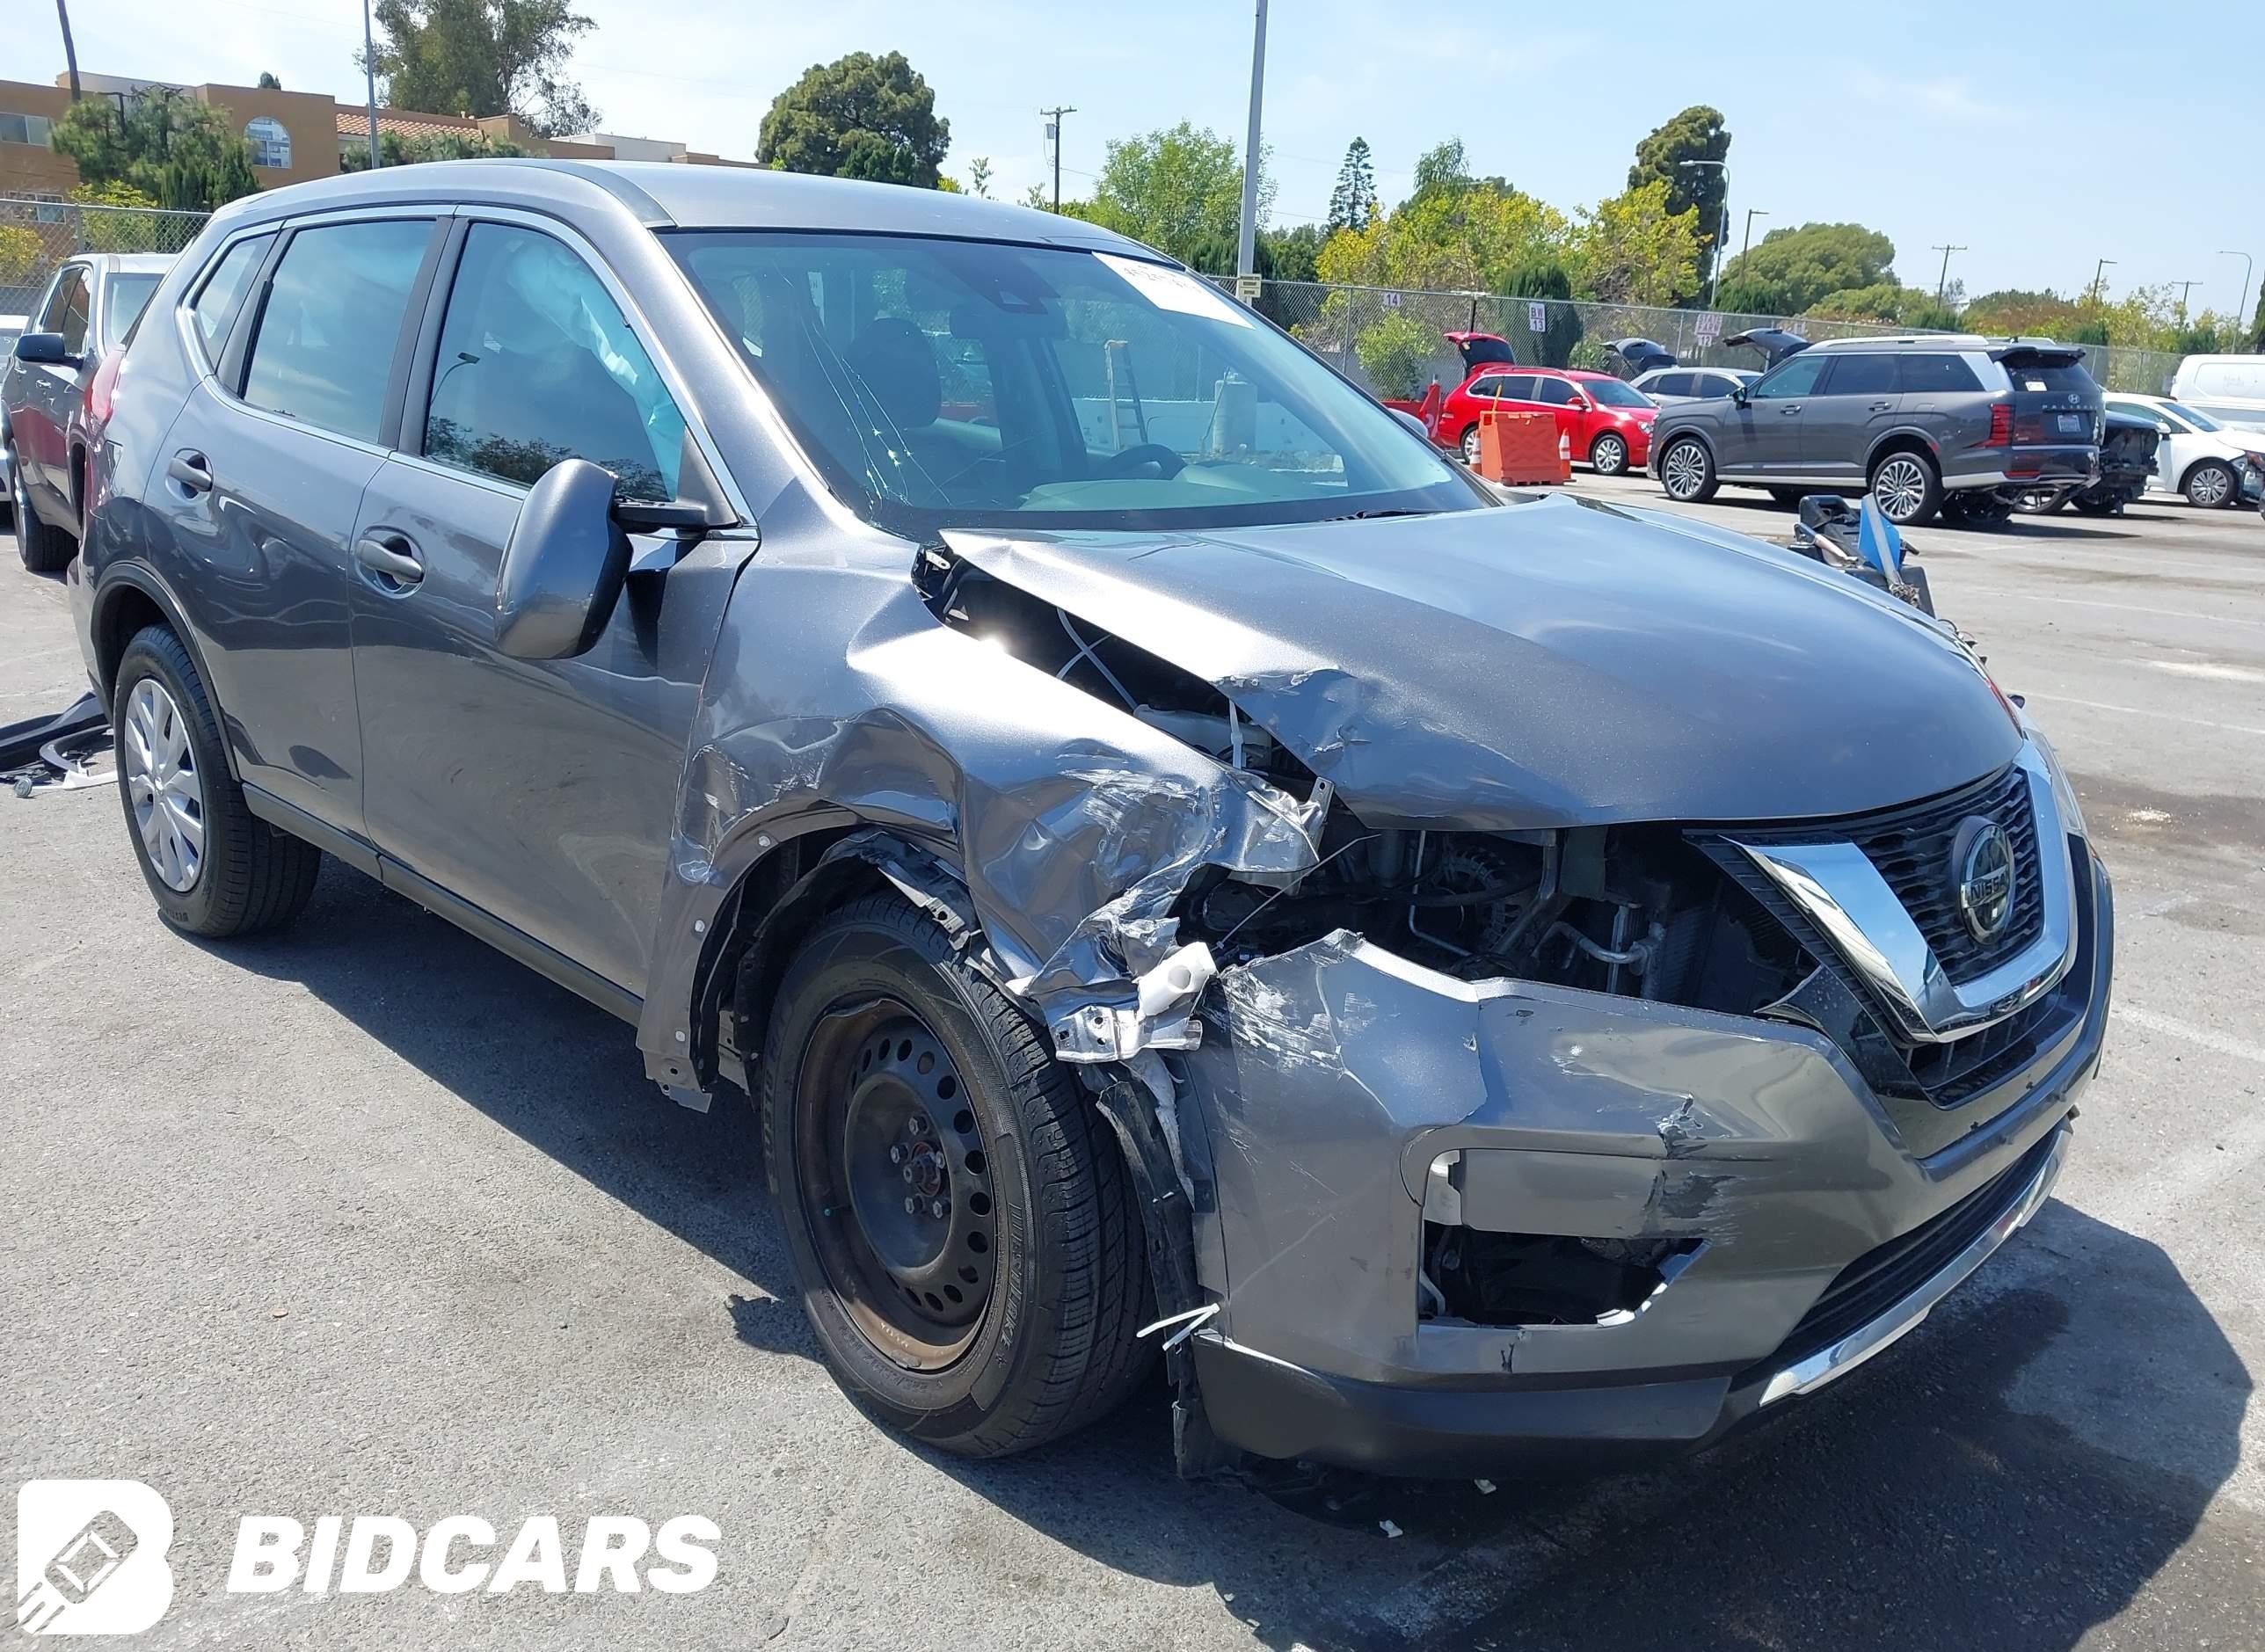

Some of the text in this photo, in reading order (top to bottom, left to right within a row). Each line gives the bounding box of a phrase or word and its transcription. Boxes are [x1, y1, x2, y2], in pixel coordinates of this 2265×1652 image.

[1387, 294, 1398, 306] 14
[1531, 307, 1544, 317] BW
[1533, 320, 1544, 331] 13
[1701, 336, 1712, 346] 12
